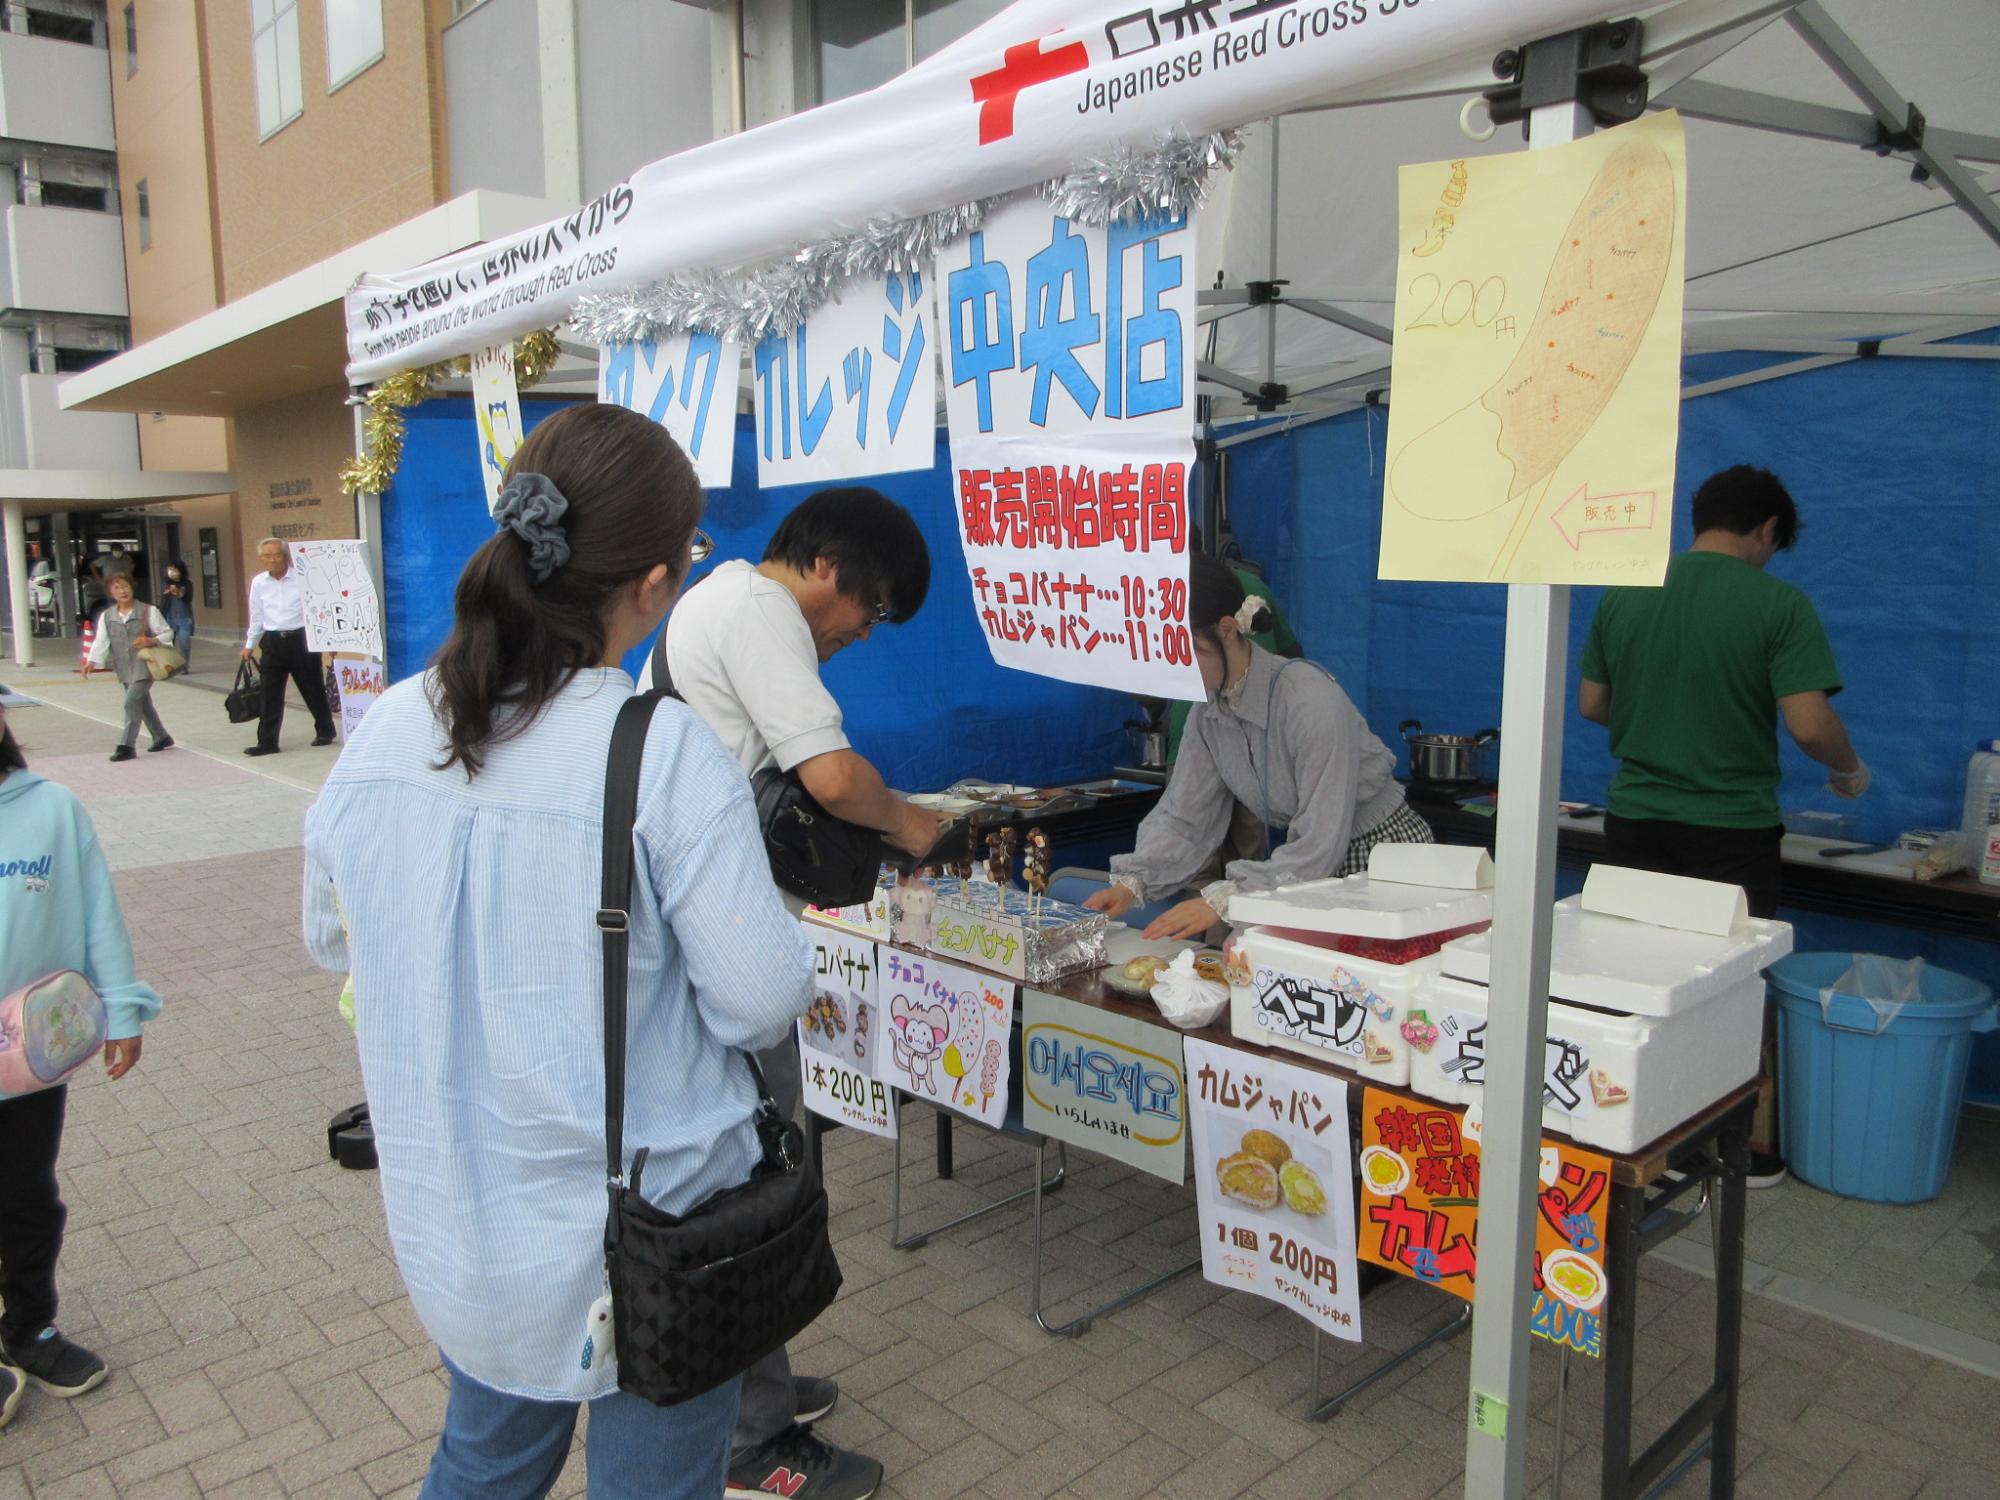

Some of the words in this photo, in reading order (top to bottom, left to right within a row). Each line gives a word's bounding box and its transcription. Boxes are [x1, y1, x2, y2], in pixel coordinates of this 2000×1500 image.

[1077, 49, 1203, 114] Japanese
[1212, 17, 1269, 71] Red
[1276, 0, 1369, 49] Cross
[364, 341, 386, 359] From
[396, 323, 421, 349] people
[423, 312, 452, 340] around
[454, 302, 470, 328] the
[471, 291, 500, 319] world
[500, 274, 547, 309] through
[546, 260, 575, 294] Red
[577, 247, 618, 282] Cross
[948, 204, 1188, 432] 中央店
[1404, 273, 1516, 340] 200円
[755, 270, 926, 462] カレッジ
[959, 462, 1185, 554] 販売開始時間
[1585, 502, 1636, 523] 販売中
[816, 945, 870, 992] コバナナ
[983, 989, 1004, 1011] 200
[1260, 977, 1368, 1047] ベーコン
[1029, 1036, 1182, 1122] 어서오세요
[1197, 1062, 1333, 1136] カムジャパン
[1374, 1105, 1463, 1158] 韓国
[1217, 1222, 1259, 1252] 1個
[1268, 1231, 1338, 1295] 200円
[1273, 1275, 1352, 1327] ヤングカレッジ中央
[760, 1465, 808, 1498] N
